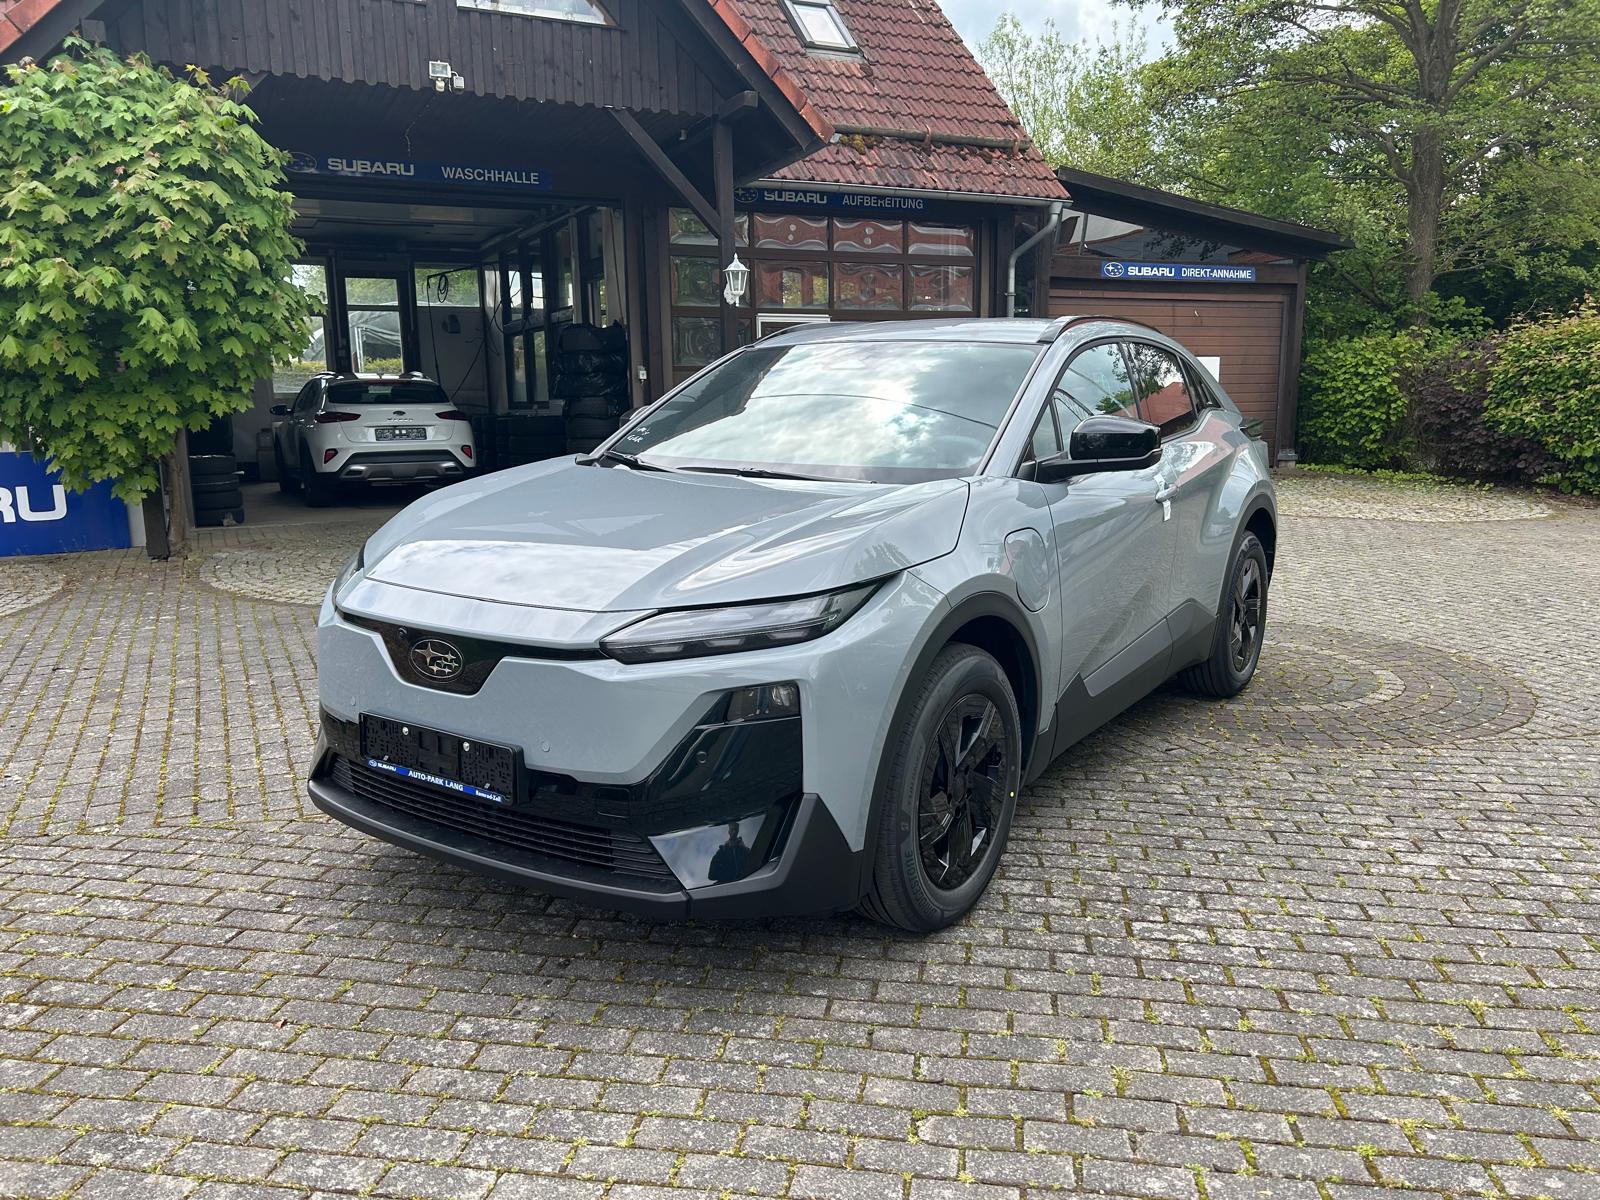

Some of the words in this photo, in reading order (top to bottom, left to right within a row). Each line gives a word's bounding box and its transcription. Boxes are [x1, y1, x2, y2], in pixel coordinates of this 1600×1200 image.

[327, 158, 415, 176] SUBARU
[441, 166, 540, 184] WASCHHALLE
[764, 190, 828, 204] SUBARU
[842, 194, 924, 209] AUFBEREITUNG
[1127, 266, 1175, 277] SUBARU
[1181, 267, 1252, 279] DIREKT-ANNAHME
[408, 770, 444, 786] AUTO-PARK
[445, 779, 464, 792] LANG
